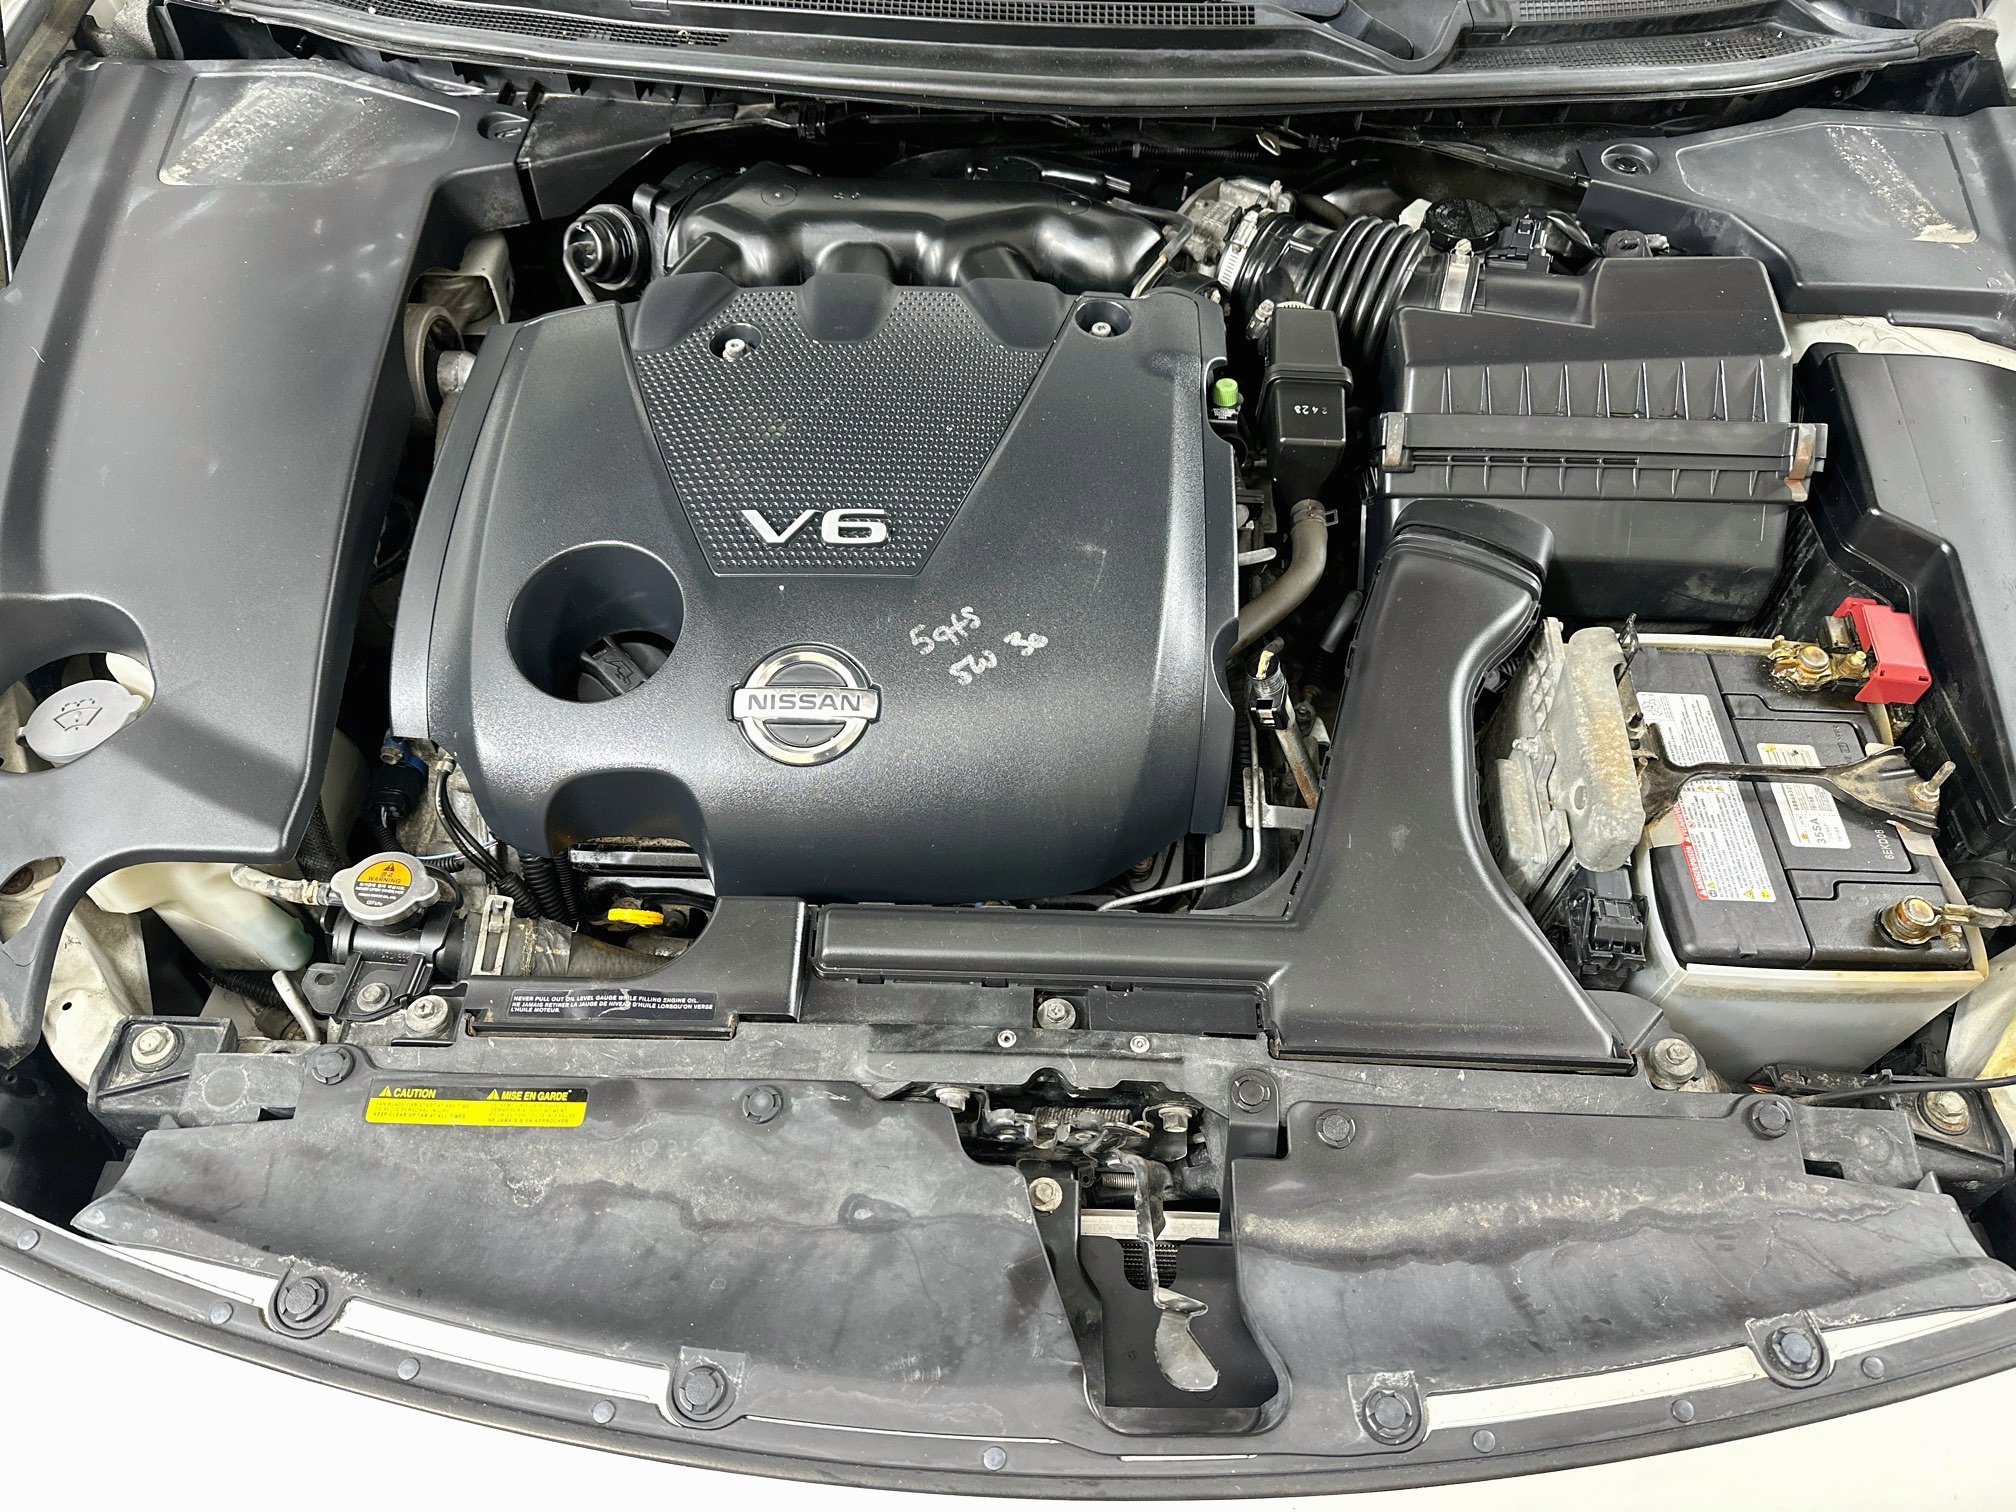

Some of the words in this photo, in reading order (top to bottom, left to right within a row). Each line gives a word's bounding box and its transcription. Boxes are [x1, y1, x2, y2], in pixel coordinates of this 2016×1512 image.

[740, 508, 890, 548] V6
[748, 694, 861, 711] NISSAN
[393, 1088, 436, 1098] CAUTION
[500, 1091, 523, 1101] MISE
[523, 1091, 537, 1101] EN
[537, 1091, 569, 1101] GARDE
